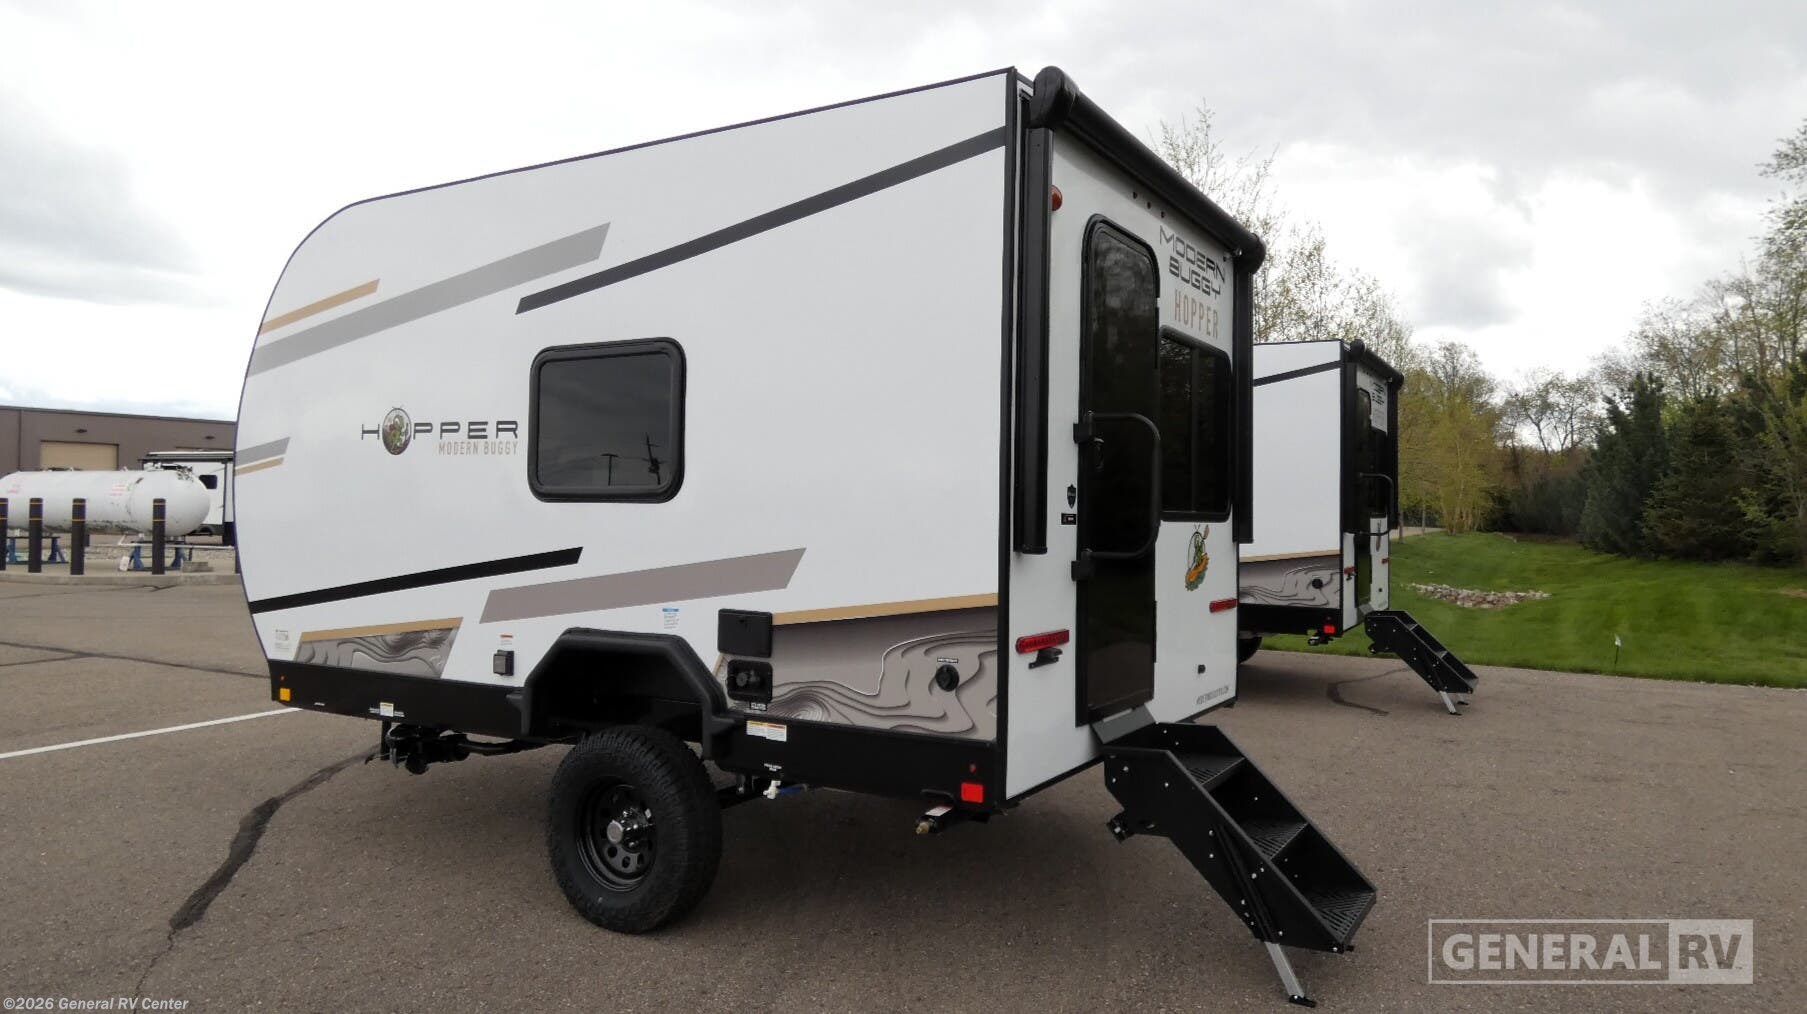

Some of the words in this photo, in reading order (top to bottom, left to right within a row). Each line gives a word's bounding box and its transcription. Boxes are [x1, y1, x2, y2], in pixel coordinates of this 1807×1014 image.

[1160, 225, 1225, 283] MODERN
[1169, 256, 1221, 299] BUGGY
[1175, 289, 1218, 339] HOPPER
[438, 442, 479, 455] MODERN
[484, 442, 518, 455] BUGGY
